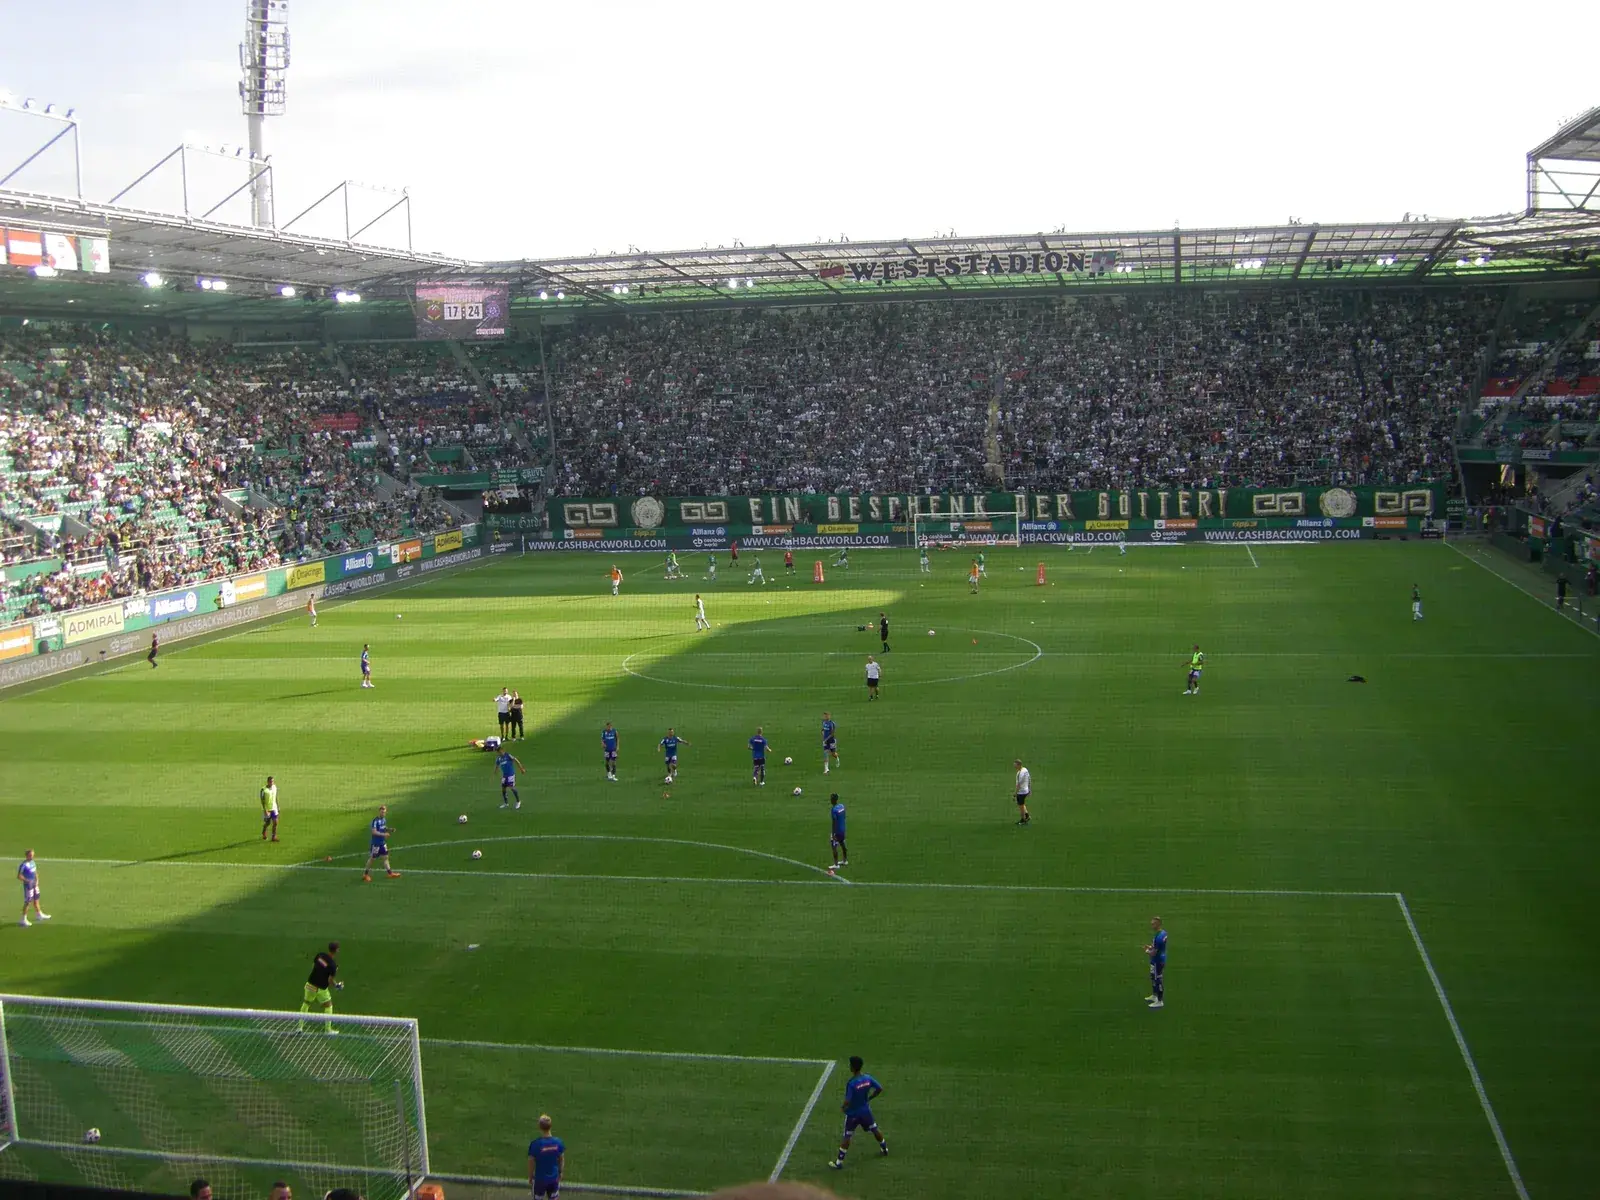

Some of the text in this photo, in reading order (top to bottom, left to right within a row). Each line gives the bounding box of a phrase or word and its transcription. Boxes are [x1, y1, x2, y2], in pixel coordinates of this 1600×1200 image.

[850, 252, 1087, 282] WESTSTADION
[749, 496, 801, 522] EIN
[827, 495, 987, 521] GESCHENK
[1014, 493, 1074, 518] DER
[692, 528, 716, 536] Allianz
[1021, 522, 1047, 531] Allianz
[1296, 519, 1322, 528] Allianz
[528, 539, 667, 550] WWW.CASHBACKWORLD.COM
[1204, 530, 1360, 541] WWW.CASHBACKWORLD.COM
[345, 550, 366, 571] Allianz
[420, 549, 481, 571] WWW.CASHBACKWORLD.COM
[154, 598, 185, 616] Allianz
[68, 614, 122, 637] ADMIRAL
